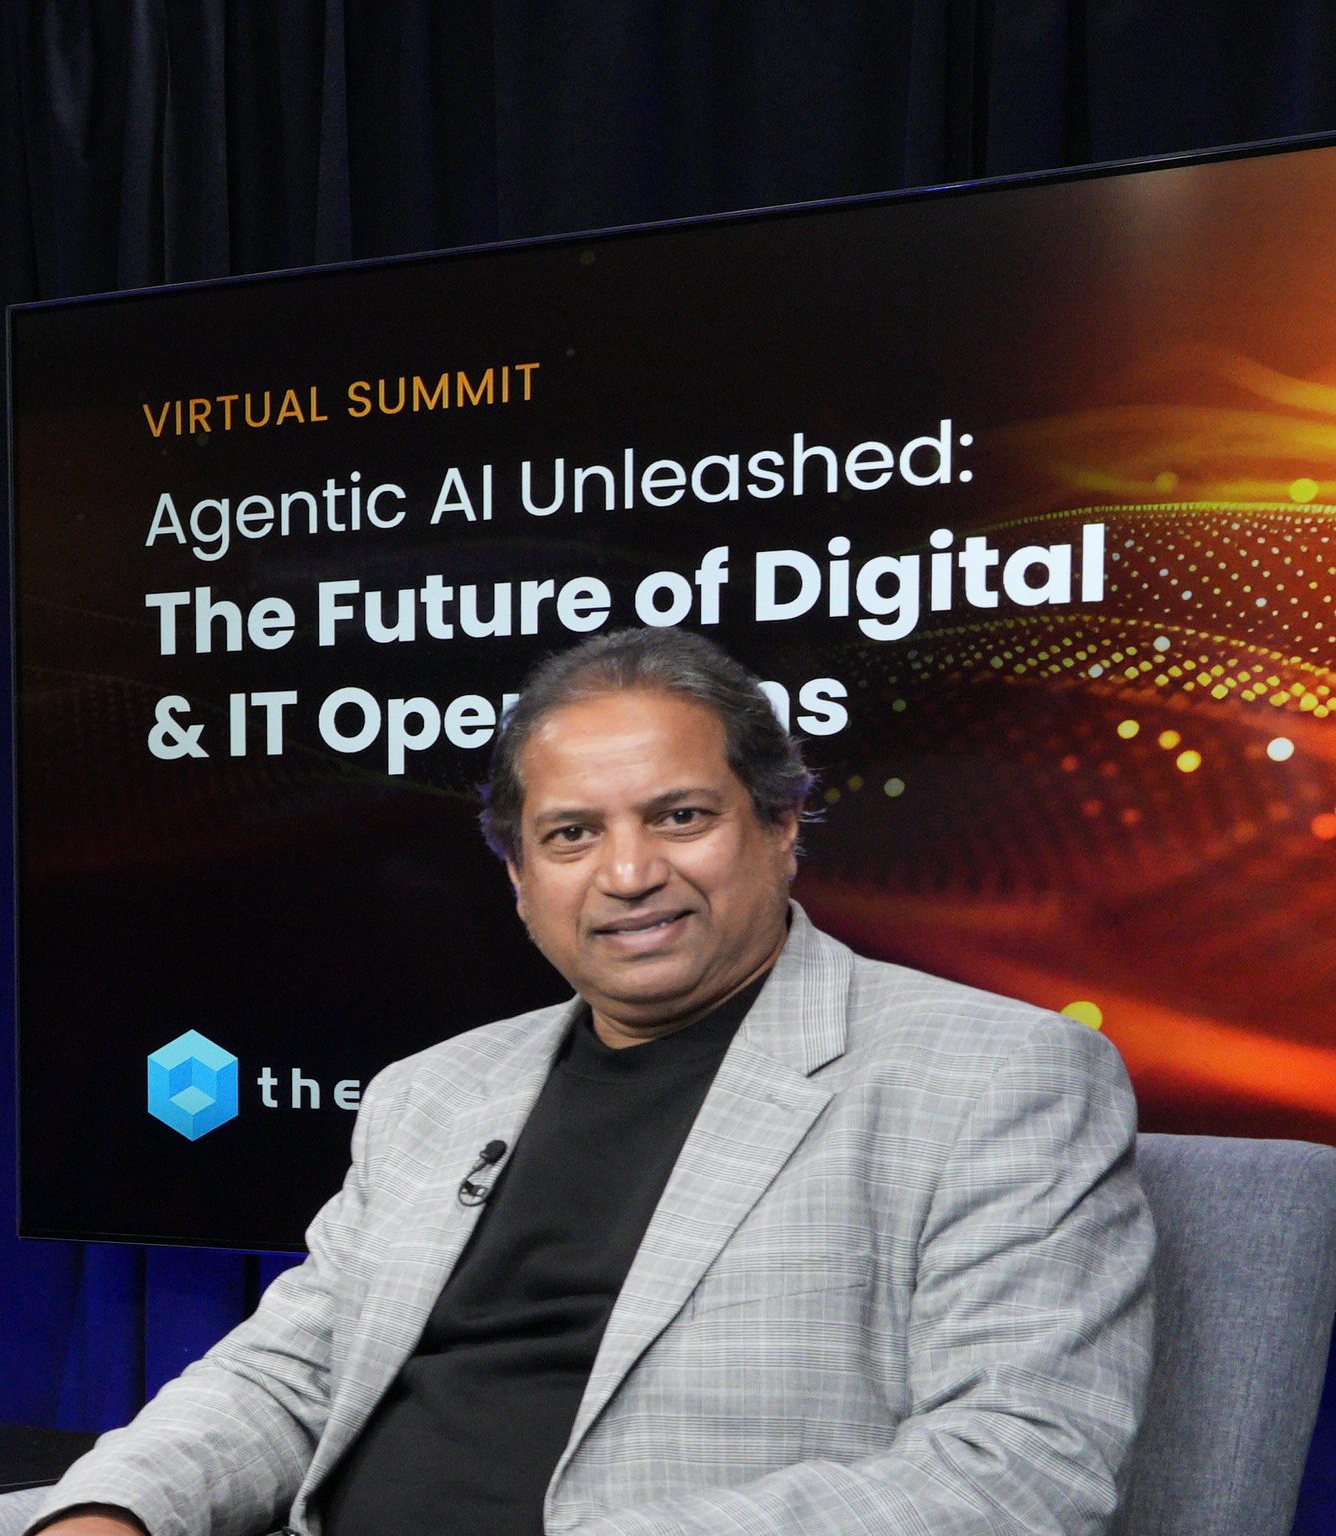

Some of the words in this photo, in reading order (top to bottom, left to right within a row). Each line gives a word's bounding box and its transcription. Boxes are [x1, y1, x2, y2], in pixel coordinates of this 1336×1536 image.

[144, 387, 328, 438] VIRTUAL
[347, 362, 541, 418] SUMMIT
[145, 470, 407, 562] Agentic
[430, 464, 493, 525] AI
[521, 418, 974, 517] Unleashed:
[145, 586, 296, 656] The
[318, 574, 612, 647] Future
[634, 545, 729, 629] of
[755, 522, 1105, 642] Digital
[147, 695, 210, 760] &
[229, 690, 298, 757] IT
